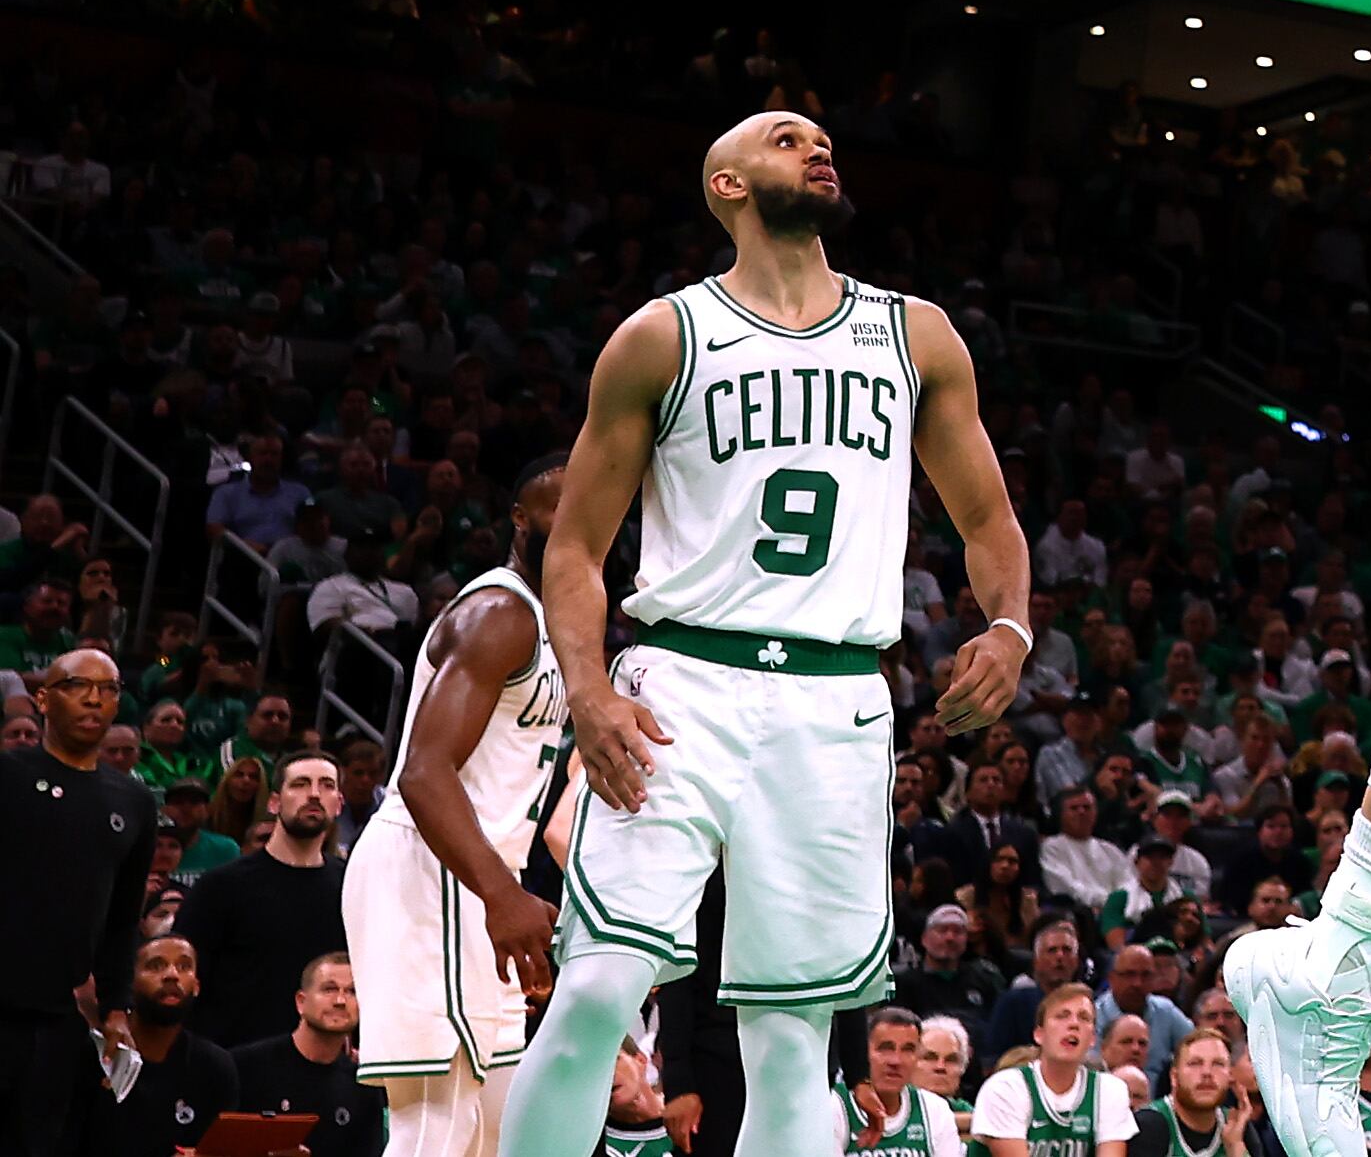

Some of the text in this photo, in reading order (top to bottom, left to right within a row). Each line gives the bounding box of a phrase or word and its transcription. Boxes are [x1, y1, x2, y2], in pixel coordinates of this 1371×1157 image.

[850, 323, 889, 337] VISTA
[853, 337, 890, 348] PRINT
[704, 368, 897, 465] CELTICS
[752, 468, 840, 577] 9
